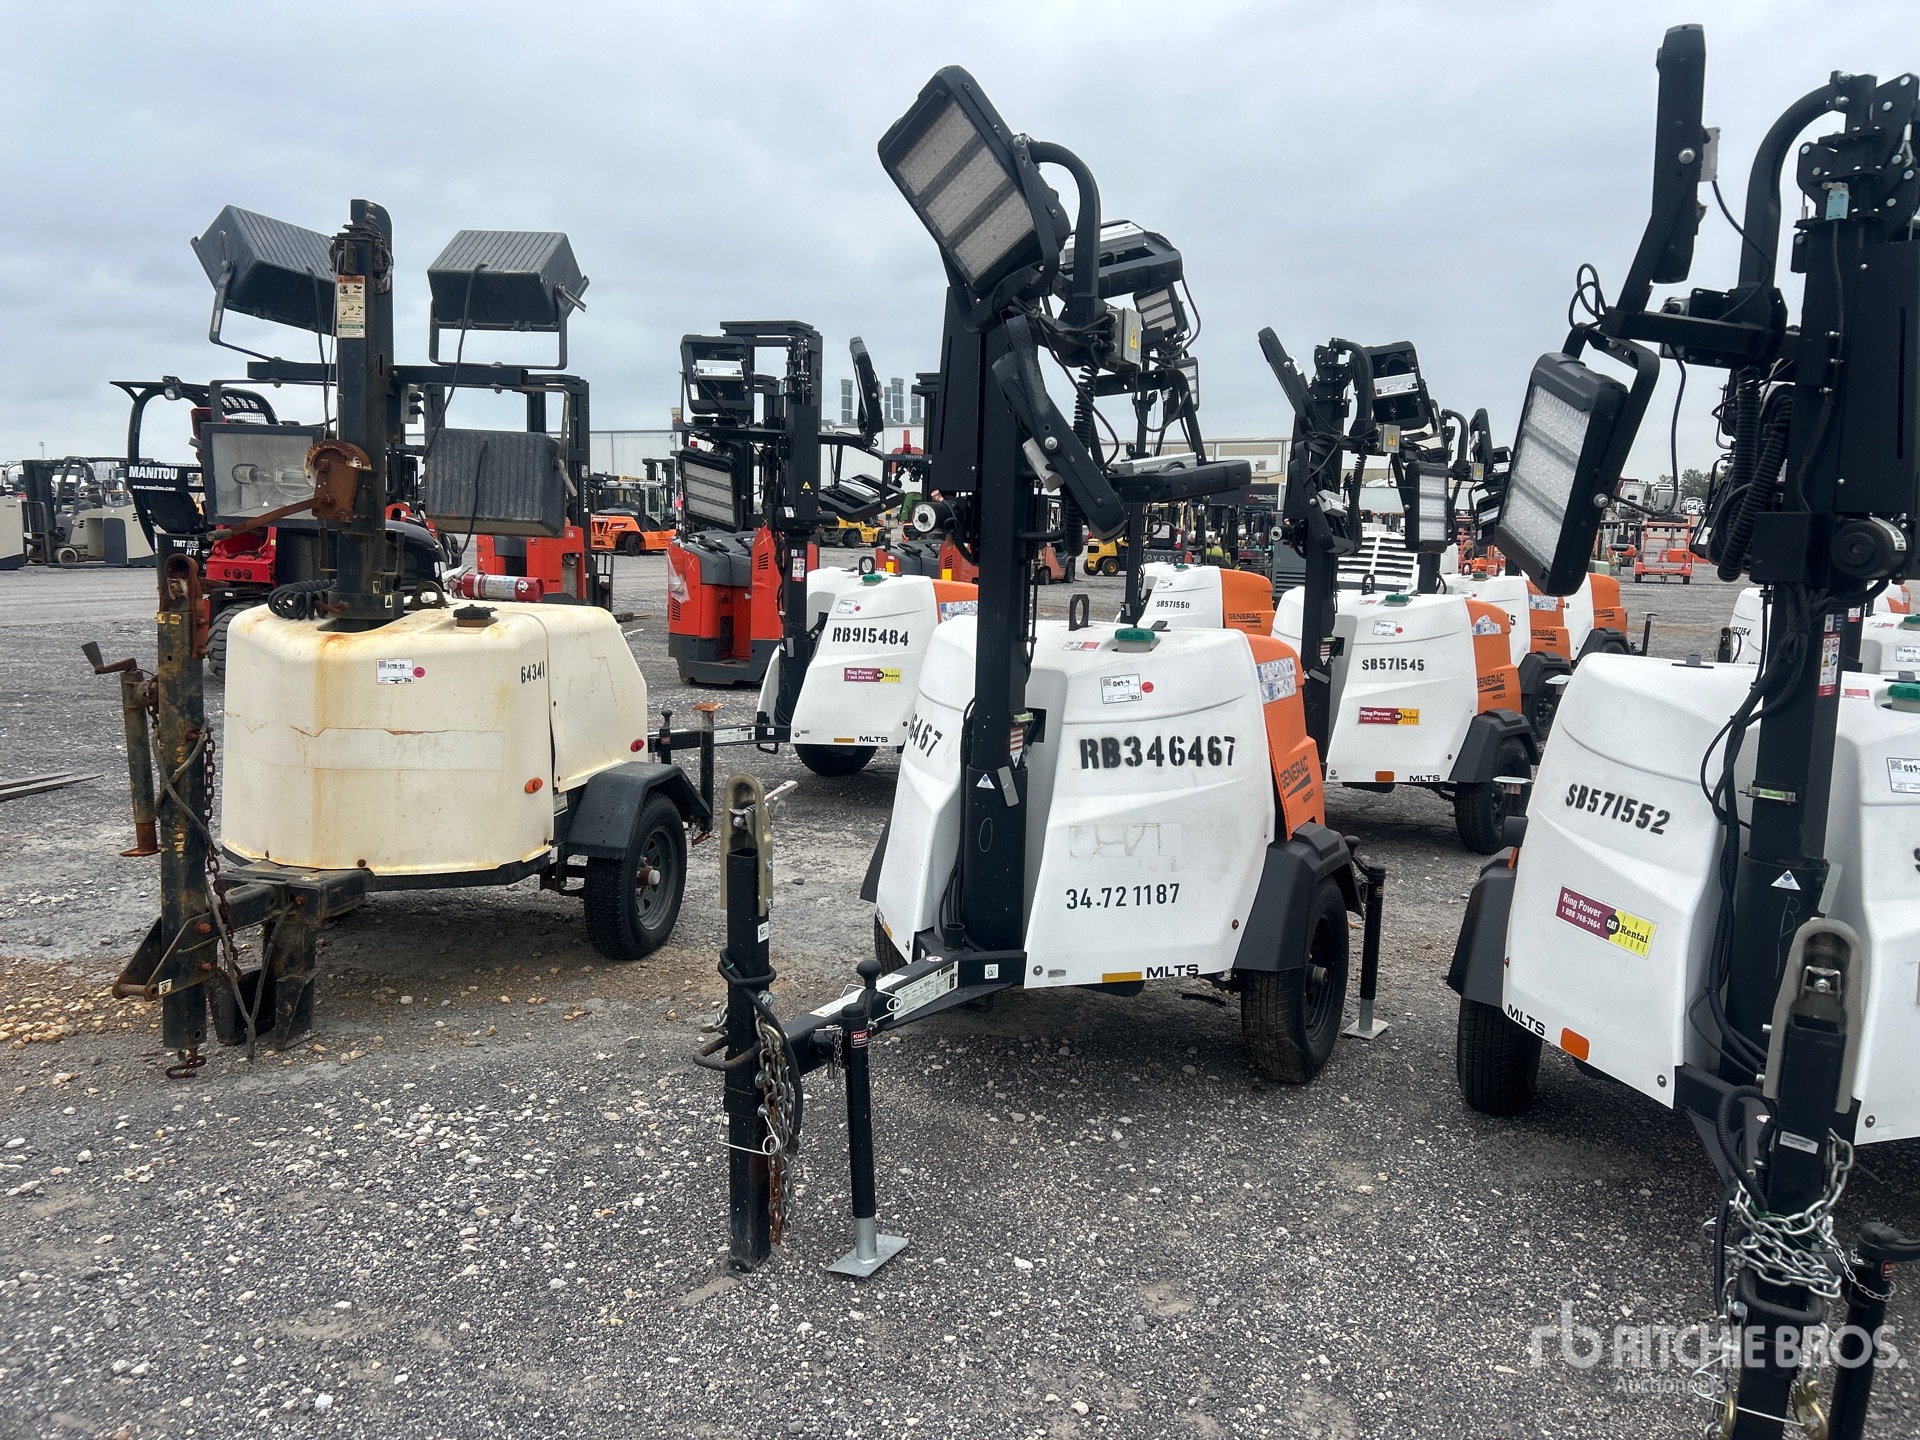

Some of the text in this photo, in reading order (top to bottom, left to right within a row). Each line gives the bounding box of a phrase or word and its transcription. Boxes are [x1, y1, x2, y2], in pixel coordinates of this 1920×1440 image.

[129, 465, 178, 480] MANITOU
[172, 540, 186, 548] TMT
[186, 548, 199, 556] HT
[832, 627, 909, 646] RB915484
[1531, 629, 1557, 637] GENERAC
[521, 660, 545, 684] 64341
[1362, 658, 1425, 672] SB571545
[1079, 735, 1236, 770] RB346467
[1280, 755, 1309, 790] GENERAC
[1409, 774, 1441, 782] MLTS
[1565, 783, 1671, 835] SB571552
[1562, 892, 1602, 918] Ring Power
[1606, 919, 1618, 930] CAT
[1619, 925, 1649, 943] Rental
[1145, 964, 1199, 979] MLTS
[1507, 1003, 1546, 1037] MLTS
